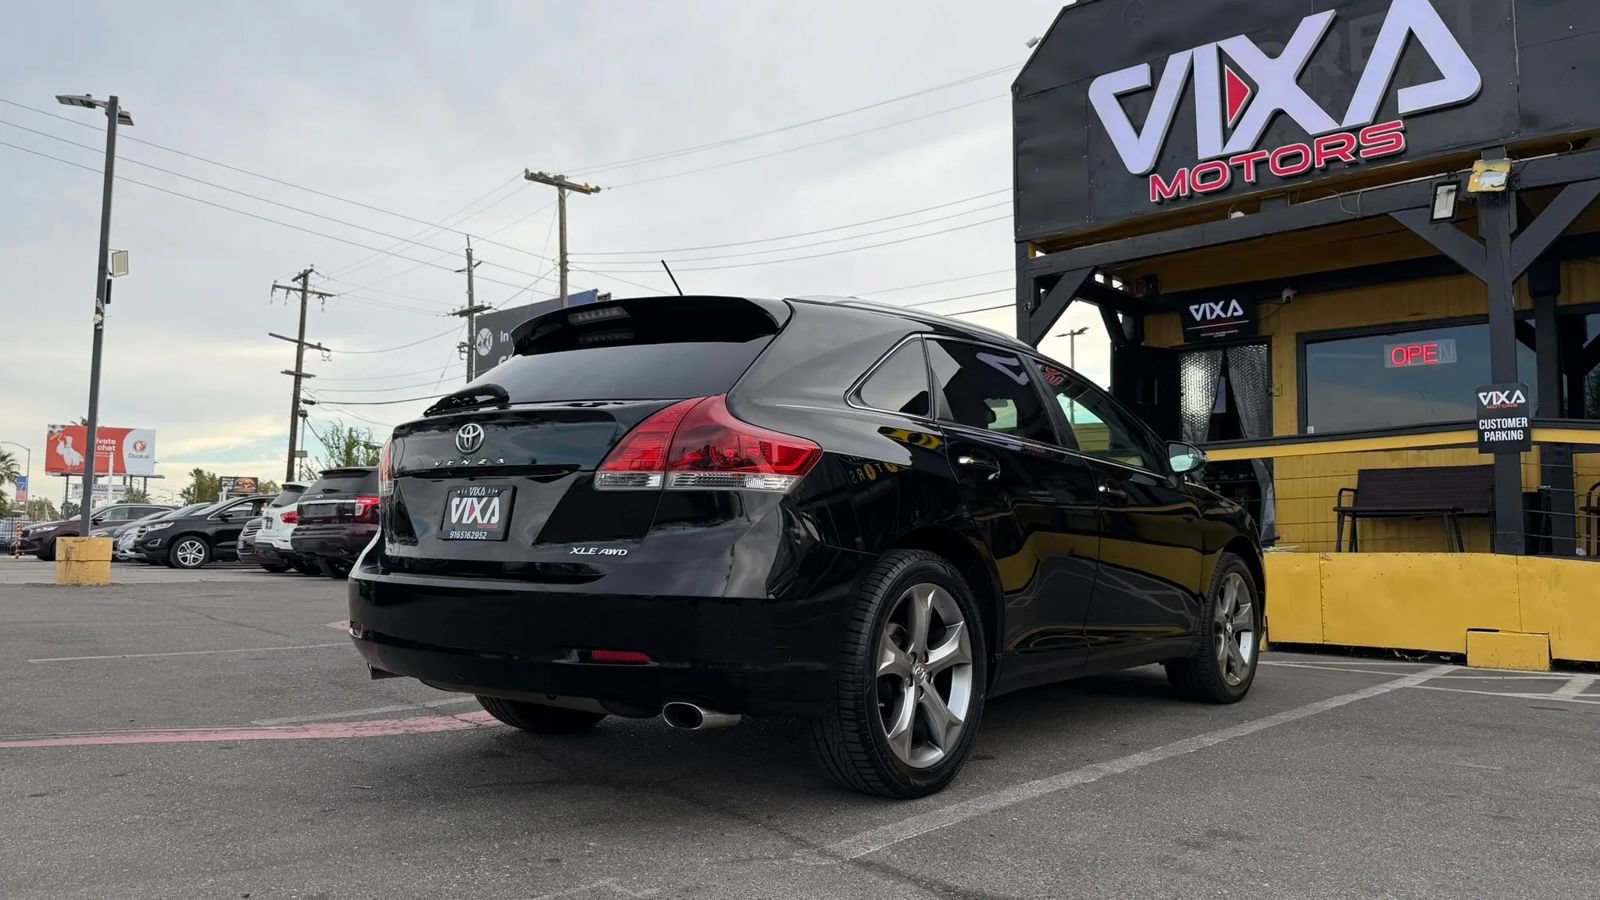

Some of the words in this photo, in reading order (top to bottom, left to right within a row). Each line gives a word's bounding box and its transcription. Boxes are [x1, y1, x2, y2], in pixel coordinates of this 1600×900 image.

[1088, 0, 1483, 175] VIXA
[1149, 119, 1407, 203] MOTORS
[1189, 298, 1244, 322] VIXA
[1391, 342, 1453, 367] OPEN
[1478, 389, 1526, 406] VIXA
[1479, 416, 1528, 430] CUSTOMER
[1484, 429, 1524, 442] PARKING
[434, 458, 505, 466] VENZA
[469, 486, 486, 496] VIXA
[451, 496, 500, 525] VIXA
[449, 530, 488, 540] 9165162952
[569, 547, 599, 555] XLE
[597, 548, 628, 556] AWD
